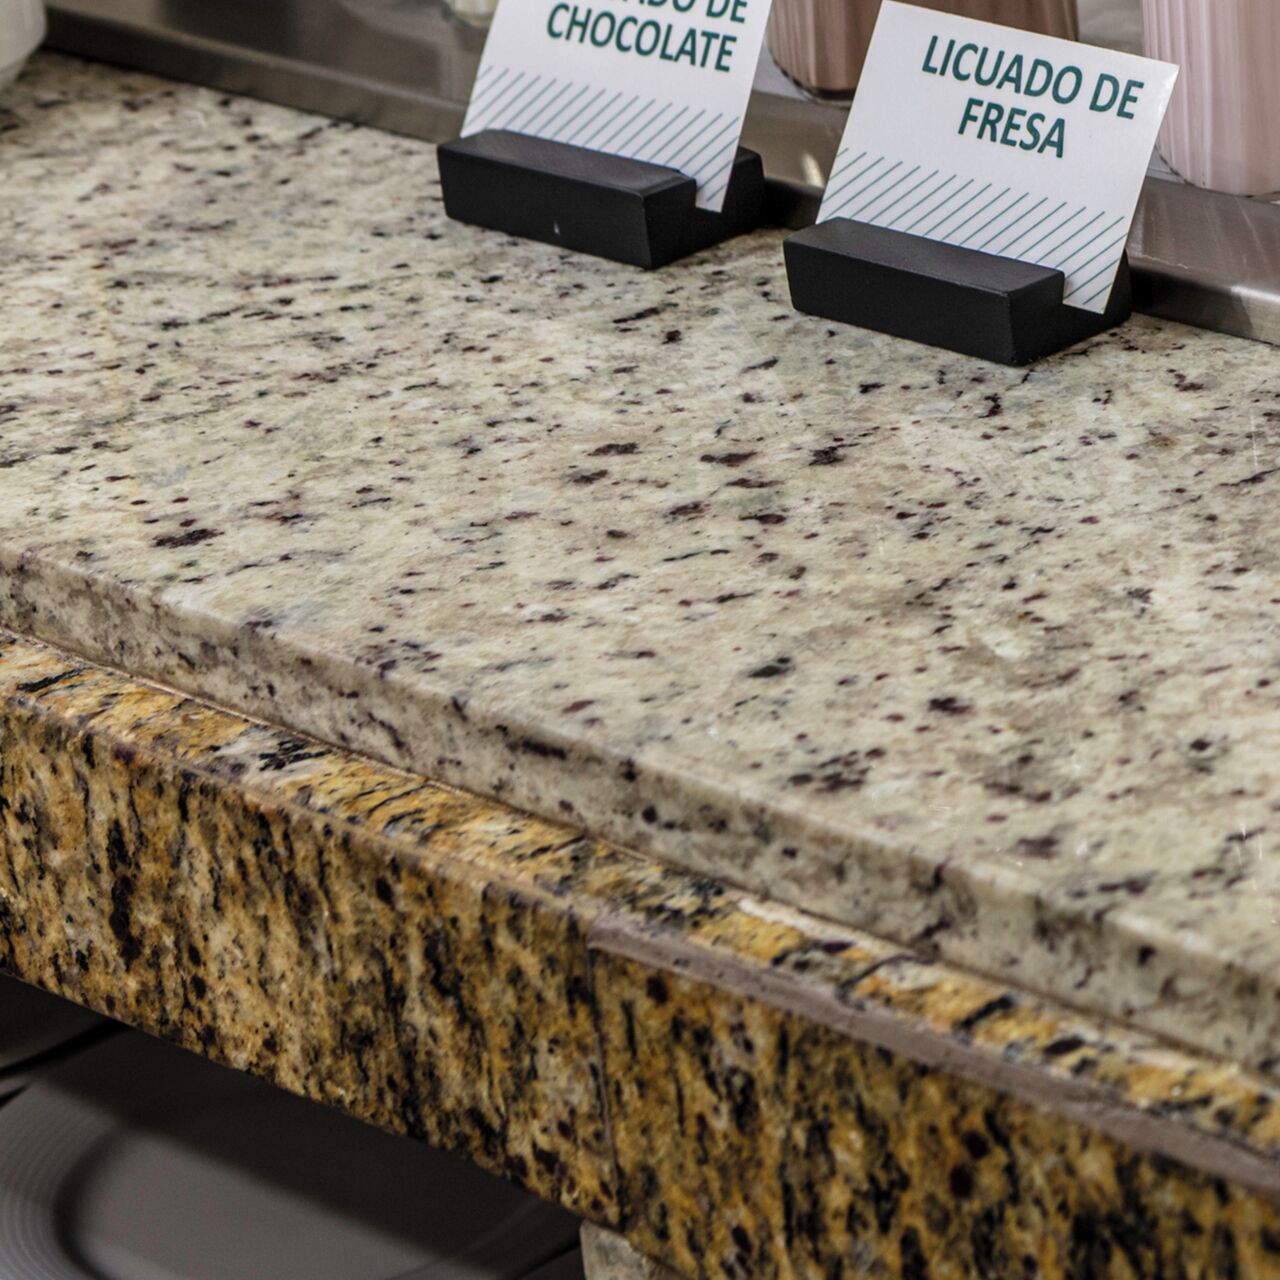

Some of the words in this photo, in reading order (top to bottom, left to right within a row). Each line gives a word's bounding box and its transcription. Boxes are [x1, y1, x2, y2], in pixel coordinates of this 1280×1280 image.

[545, 1, 738, 74] CHOCOLATE
[921, 33, 1084, 106] LICUADO
[1088, 71, 1146, 121] DE
[956, 96, 1066, 160] FRESA
